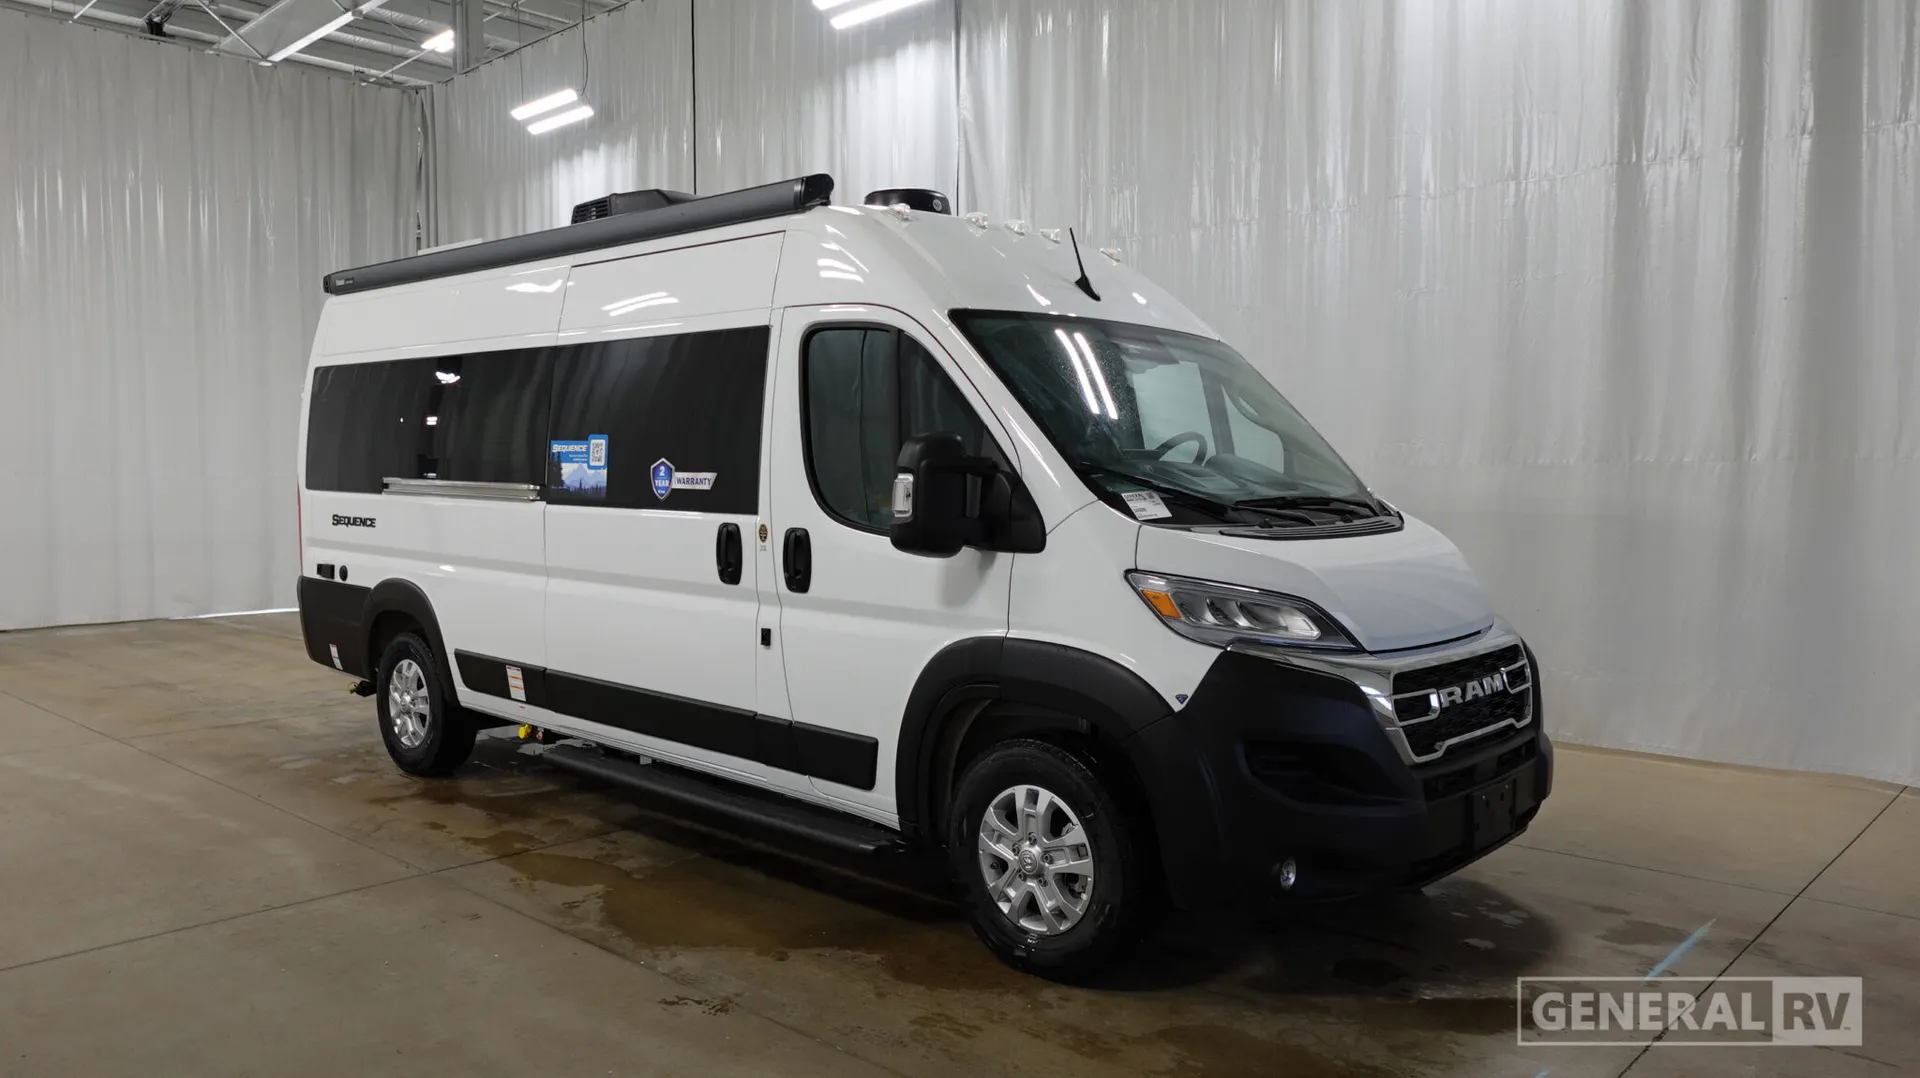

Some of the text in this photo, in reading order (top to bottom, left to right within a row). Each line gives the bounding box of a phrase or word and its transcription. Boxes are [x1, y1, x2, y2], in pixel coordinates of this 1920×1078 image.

[552, 444, 588, 453] SEQUENCE
[659, 466, 666, 476] 2
[654, 479, 670, 488] YEAR
[676, 477, 711, 486] WARRANTY
[332, 514, 376, 528] SEQUENCE
[1438, 673, 1504, 708] RAM
